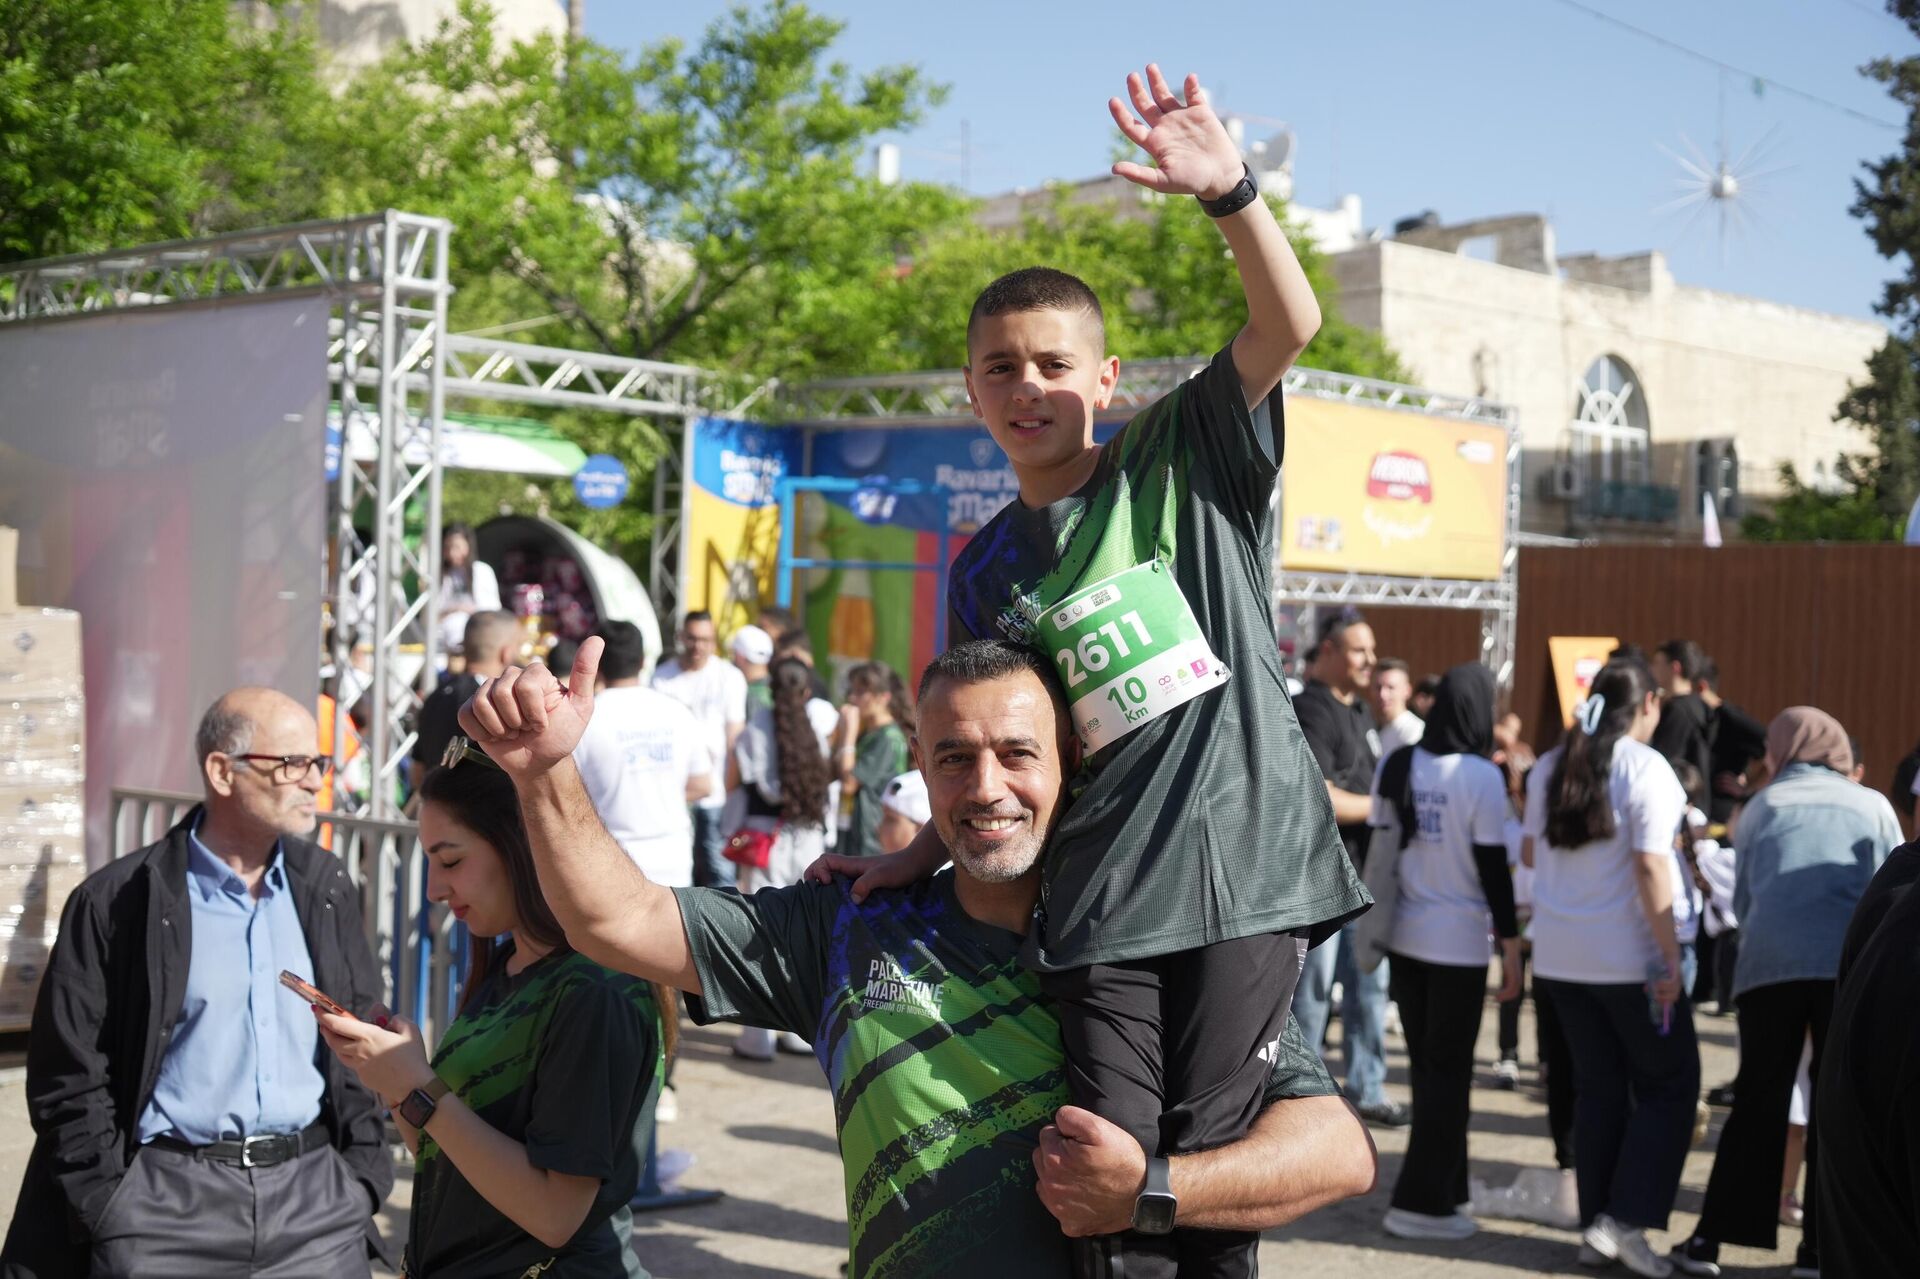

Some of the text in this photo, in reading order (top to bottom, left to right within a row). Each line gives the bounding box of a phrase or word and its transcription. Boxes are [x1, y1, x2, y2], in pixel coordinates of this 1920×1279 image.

[1056, 609, 1152, 688] 2611
[1107, 676, 1147, 713] 10
[1125, 706, 1149, 724] Km
[868, 959, 945, 1004] PALESTINE
[863, 998, 896, 1013] FREEDOM
[896, 1003, 906, 1013] OF
